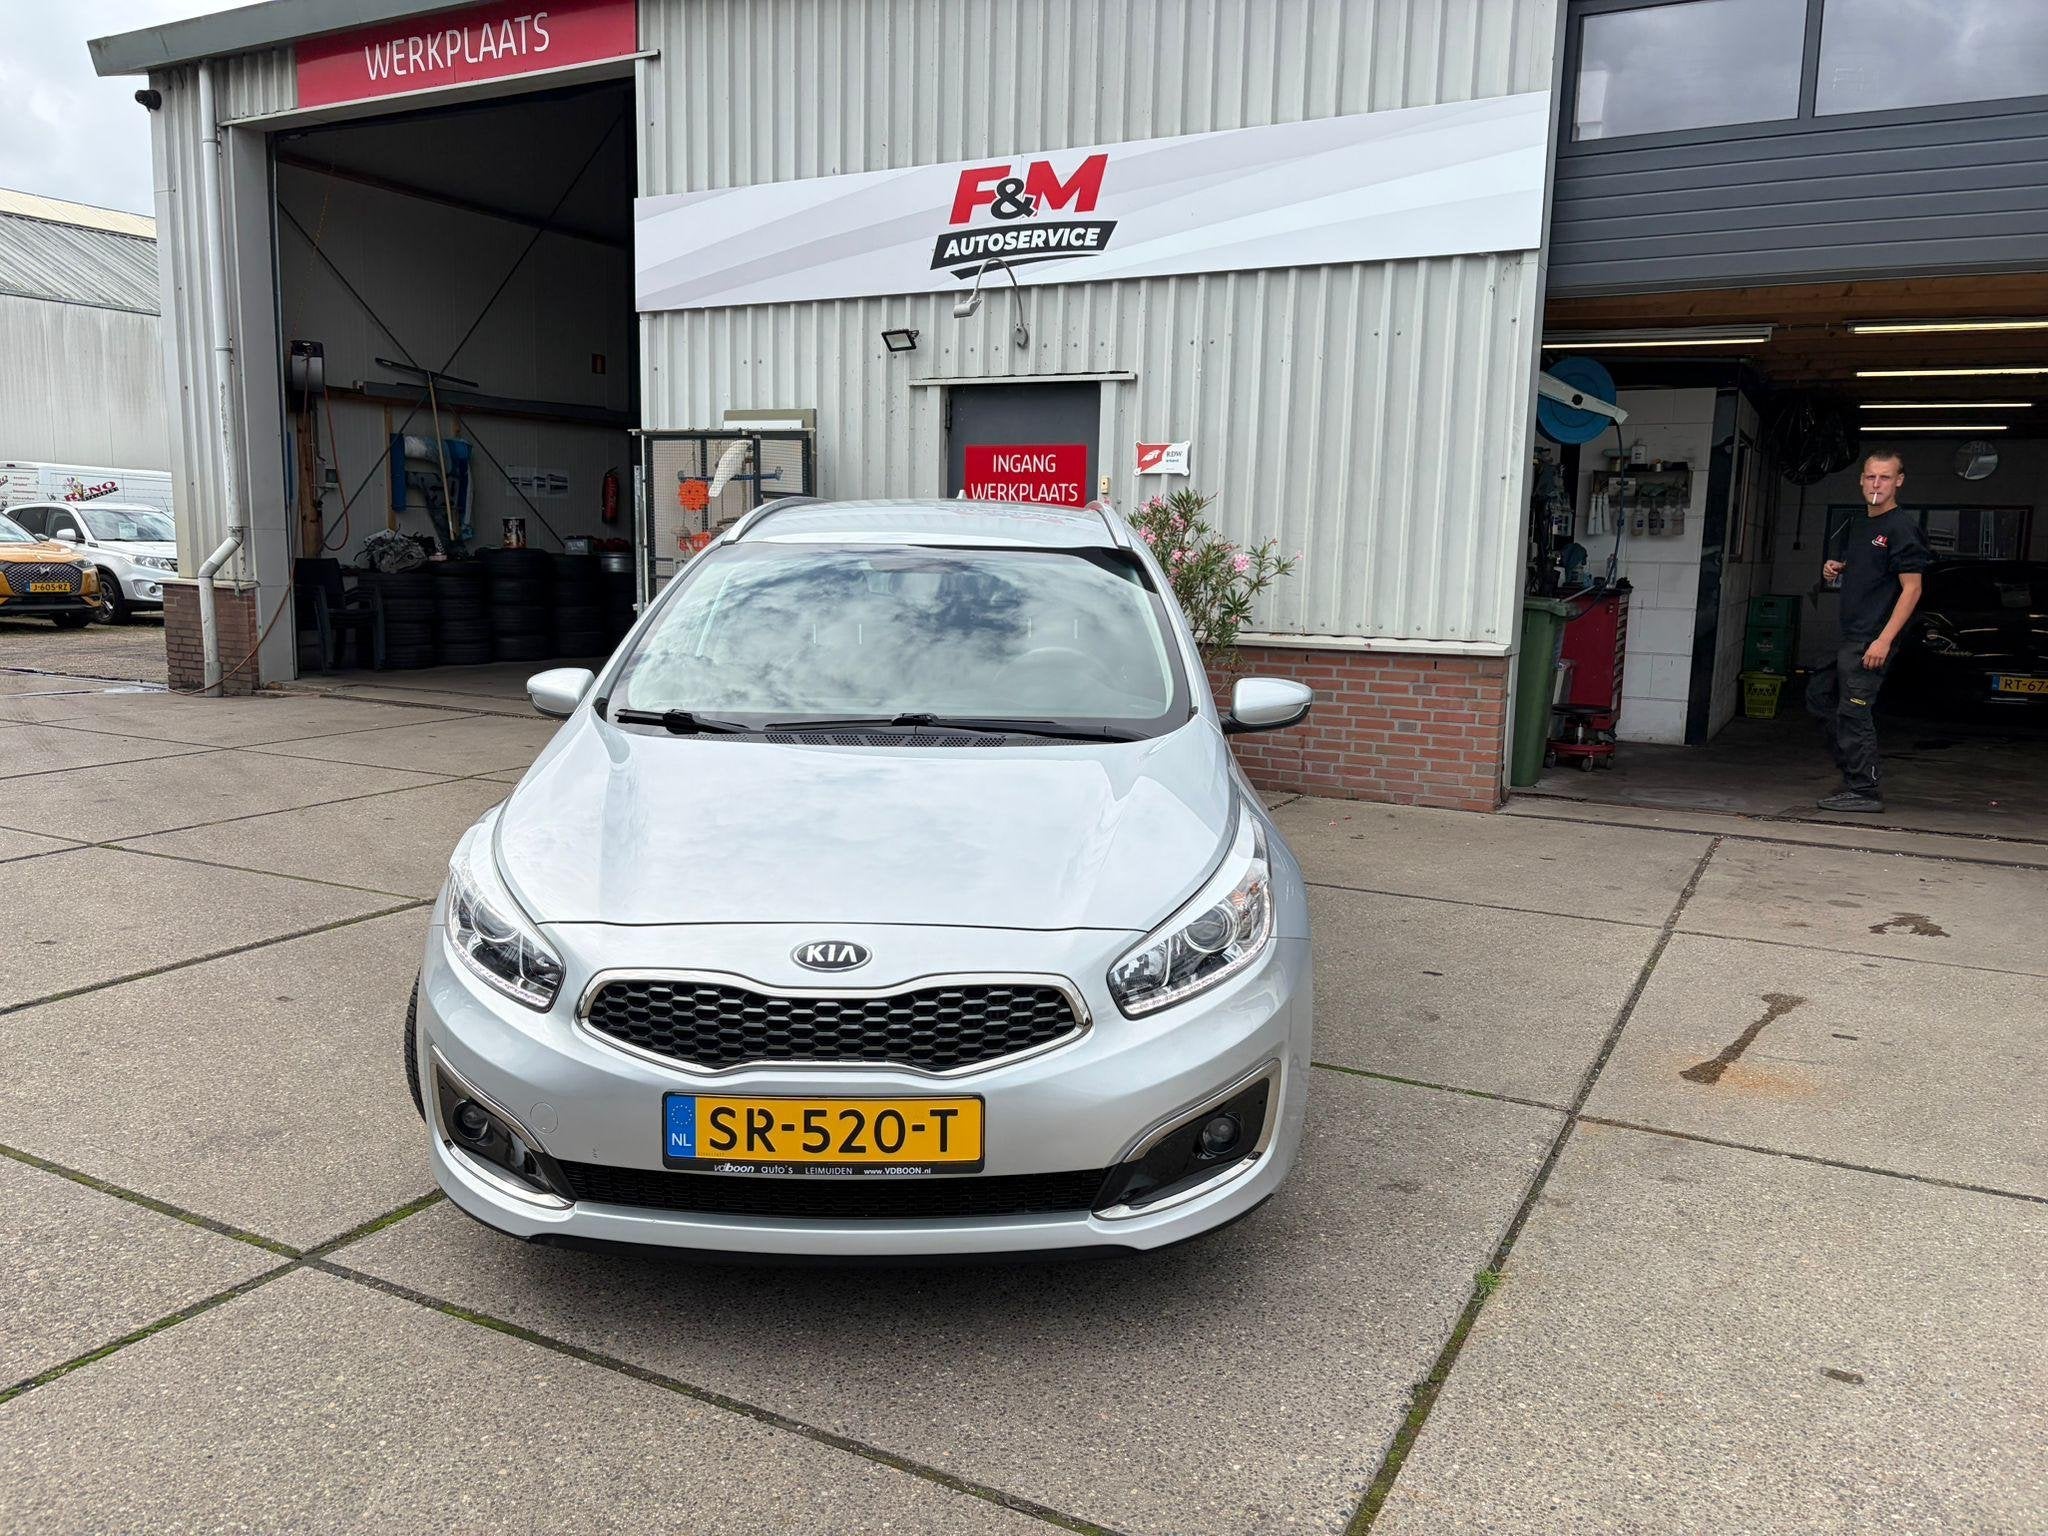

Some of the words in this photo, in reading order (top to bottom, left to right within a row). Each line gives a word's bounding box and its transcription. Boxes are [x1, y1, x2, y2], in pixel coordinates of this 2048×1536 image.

[365, 12, 550, 81] WERKPLAATS
[949, 153, 1108, 225] F&M
[943, 227, 1101, 259] AUTOSERVICE
[993, 454, 1057, 473] INGANG
[970, 483, 1079, 502] WERKPLAATS
[2004, 679, 2048, 691] RT-67
[806, 944, 858, 962] KIA
[671, 1132, 692, 1147] NL
[709, 1106, 959, 1154] SR-520-T
[805, 1167, 853, 1175] LEIMUIDEN
[863, 1166, 931, 1174] www.VDBOON.nl
